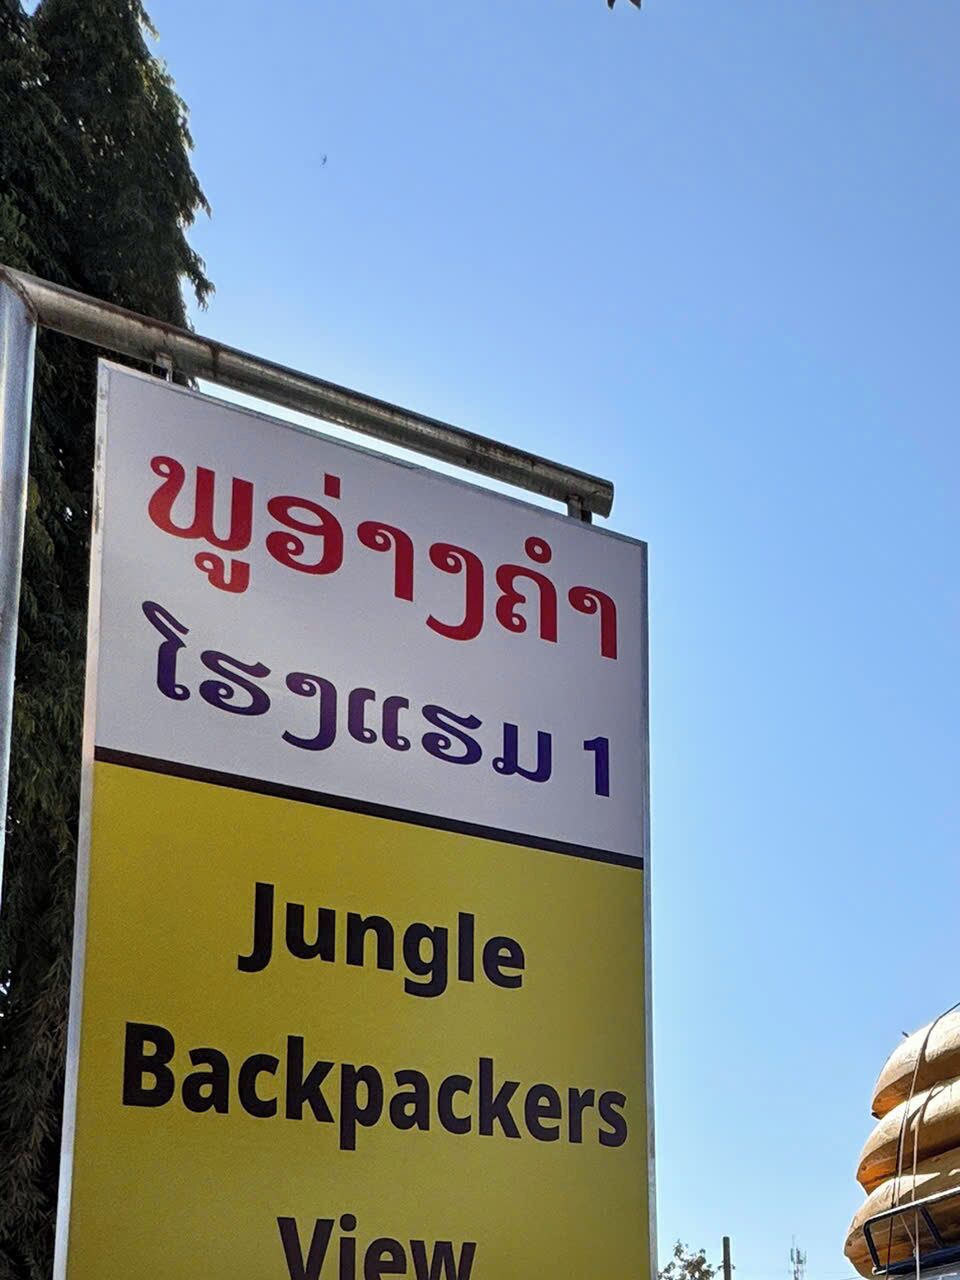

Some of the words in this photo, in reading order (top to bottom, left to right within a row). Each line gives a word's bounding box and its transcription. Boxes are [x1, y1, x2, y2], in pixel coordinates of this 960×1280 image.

[142, 600, 553, 784] ໂຮງແຮມ
[583, 736, 610, 798] 1
[237, 881, 526, 998] Jungle
[121, 1021, 628, 1151] Backpackers
